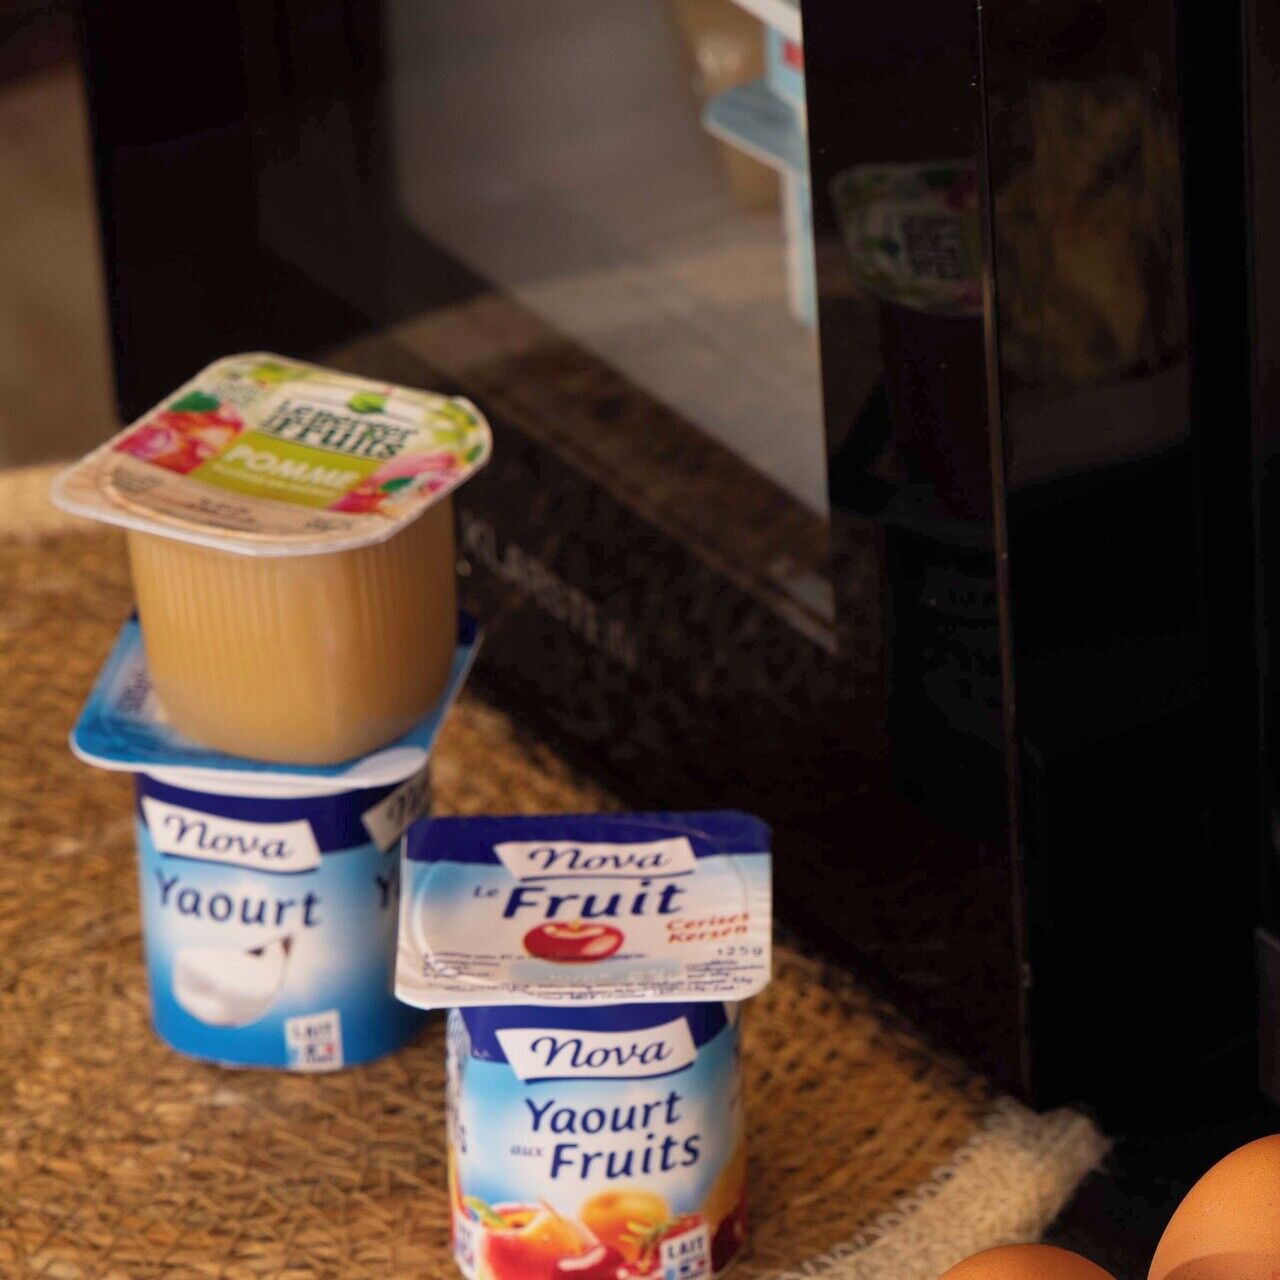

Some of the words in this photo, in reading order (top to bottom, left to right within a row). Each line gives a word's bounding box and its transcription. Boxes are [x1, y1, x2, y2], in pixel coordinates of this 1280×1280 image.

[222, 445, 361, 488] POMME
[163, 813, 293, 860] Nova
[528, 847, 672, 870] Nova
[154, 866, 322, 928] Yaourt
[473, 884, 498, 898] Le
[503, 877, 686, 919] Fruit
[668, 925, 748, 944] Kersen
[530, 1036, 673, 1070] Nova
[525, 1090, 683, 1135] Yaourt
[510, 1145, 544, 1157] aux
[549, 1133, 702, 1180] Fruits
